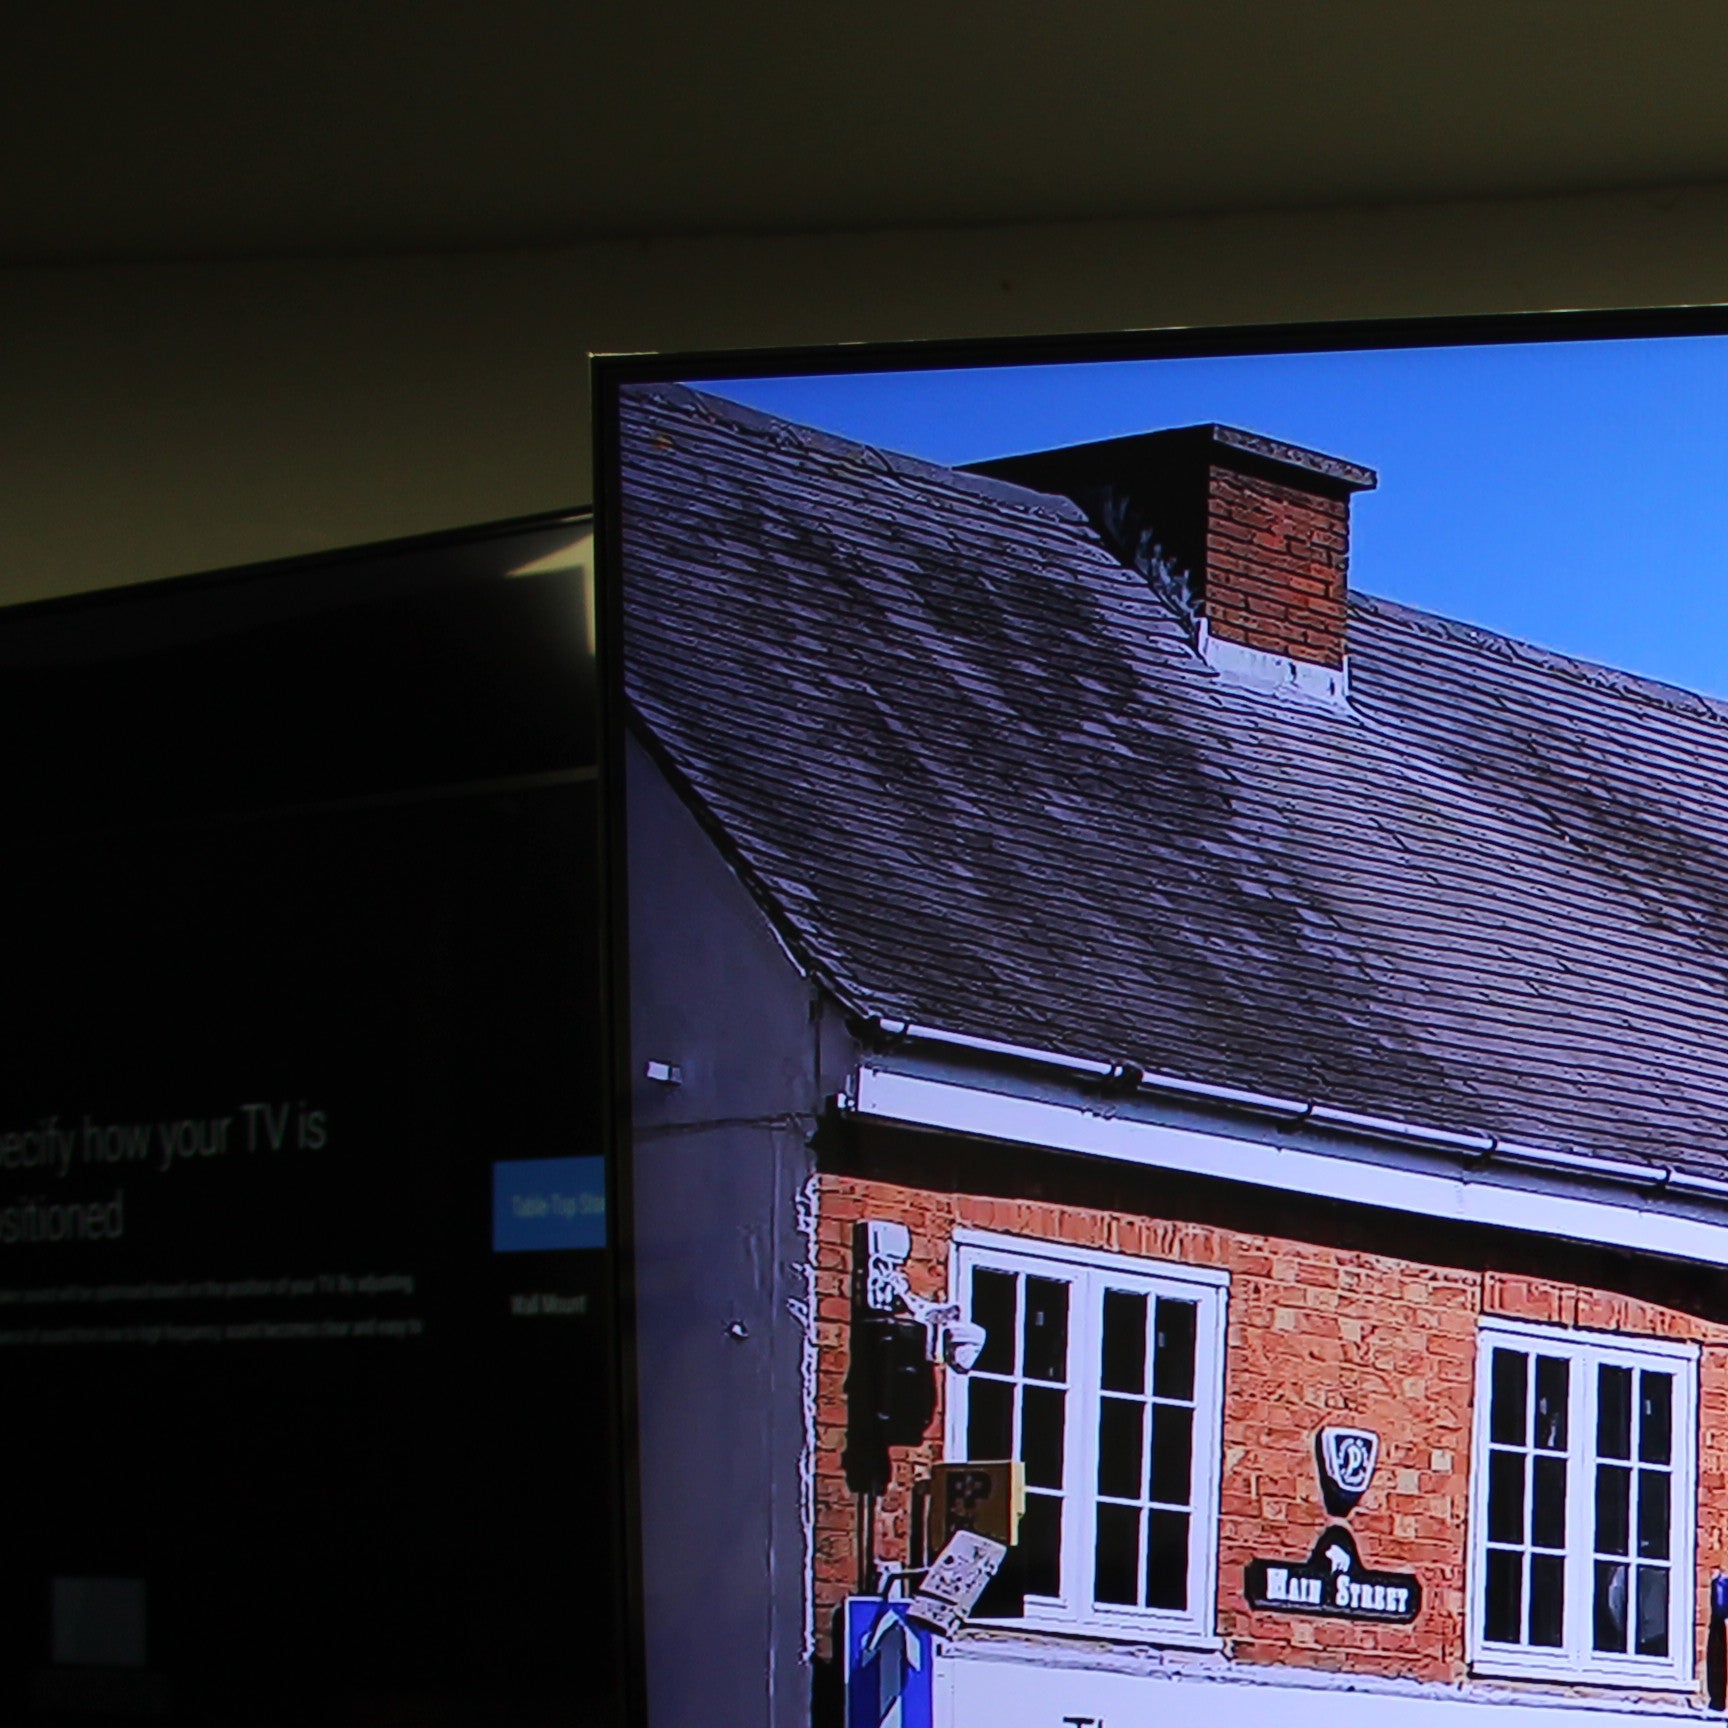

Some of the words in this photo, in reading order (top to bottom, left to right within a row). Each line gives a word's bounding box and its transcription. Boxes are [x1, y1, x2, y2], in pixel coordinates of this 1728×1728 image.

[83, 1114, 153, 1163] how
[157, 1116, 233, 1172] your
[238, 1102, 291, 1152] TV
[296, 1099, 327, 1150] is
[0, 1188, 125, 1244] sitioned
[1335, 1574, 1408, 1612] STREET
